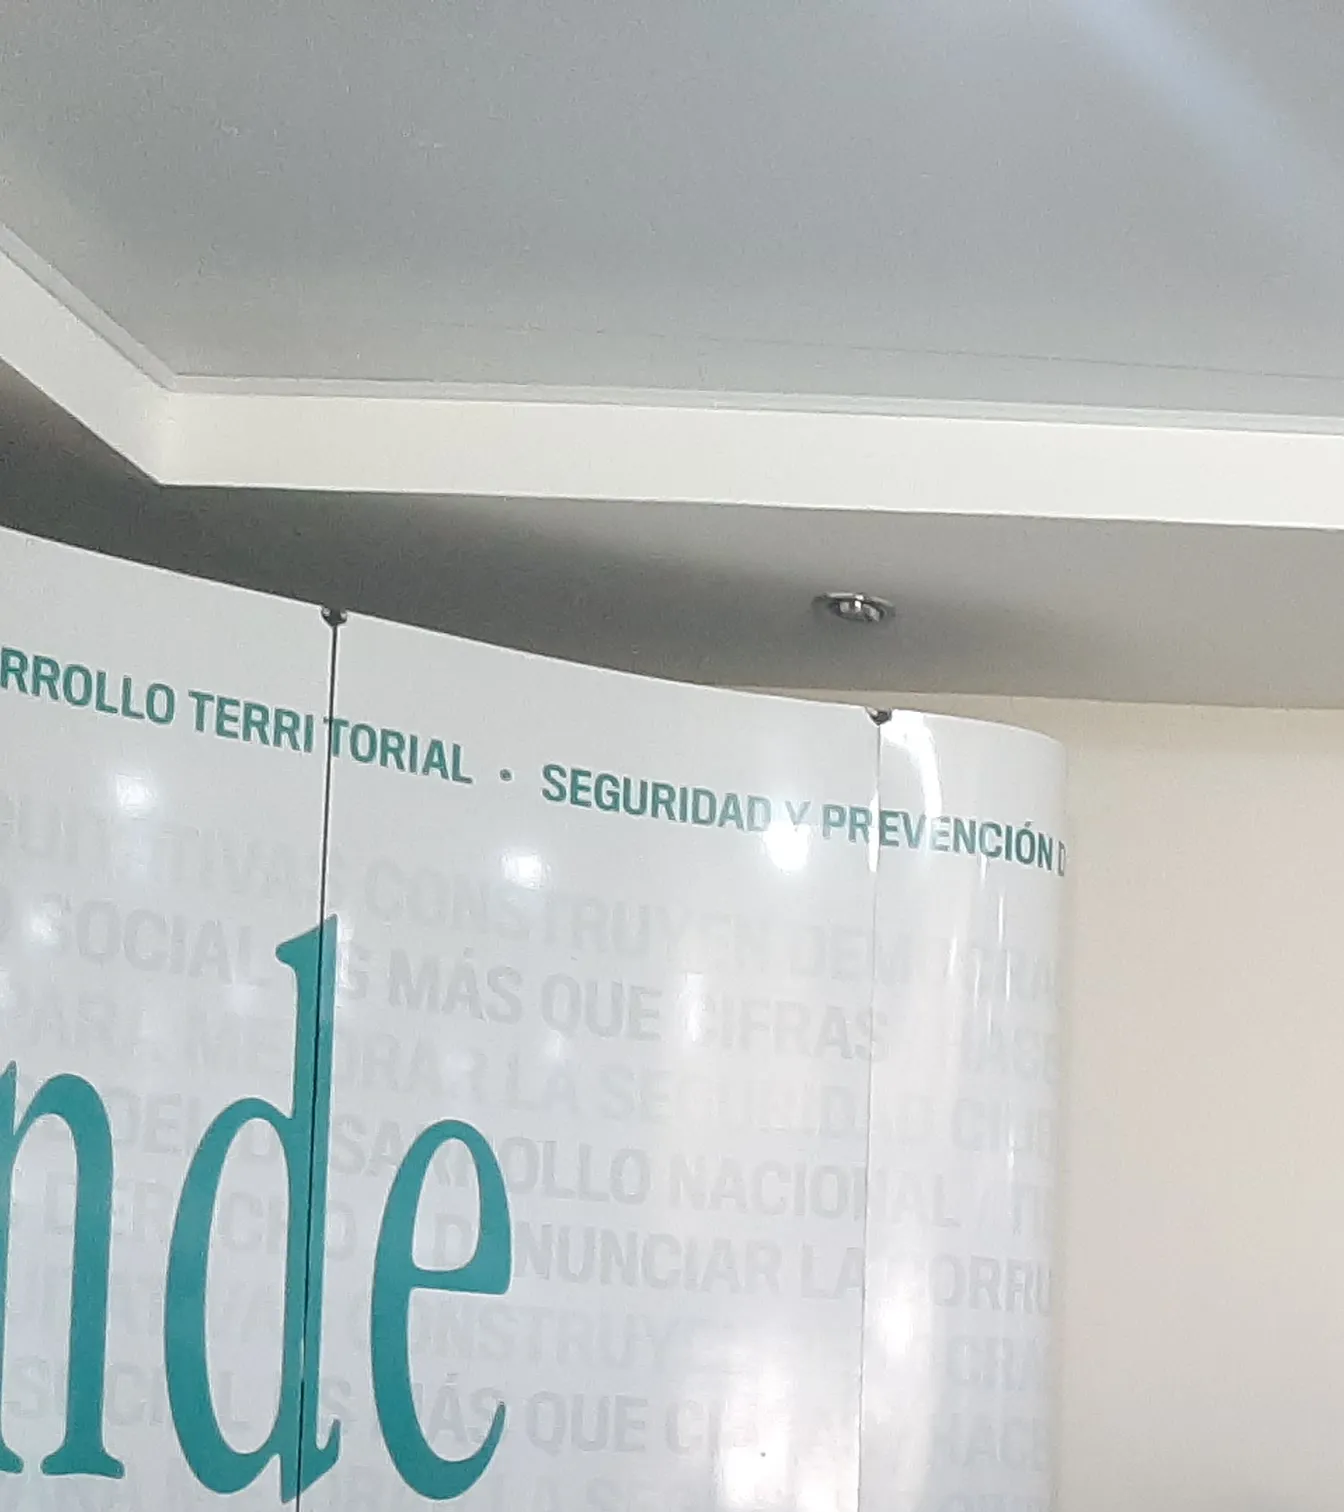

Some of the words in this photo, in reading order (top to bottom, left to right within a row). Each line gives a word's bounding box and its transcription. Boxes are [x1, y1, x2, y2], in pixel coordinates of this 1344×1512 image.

[188, 689, 474, 784] TERRITORIAL
[541, 762, 774, 833] SEGURIDAD
[785, 798, 811, 833] Y
[822, 802, 1054, 870] PREVENCIÓN
[388, 947, 524, 1024] MÁS
[540, 972, 663, 1041] QUE
[524, 1390, 650, 1457] QUE
